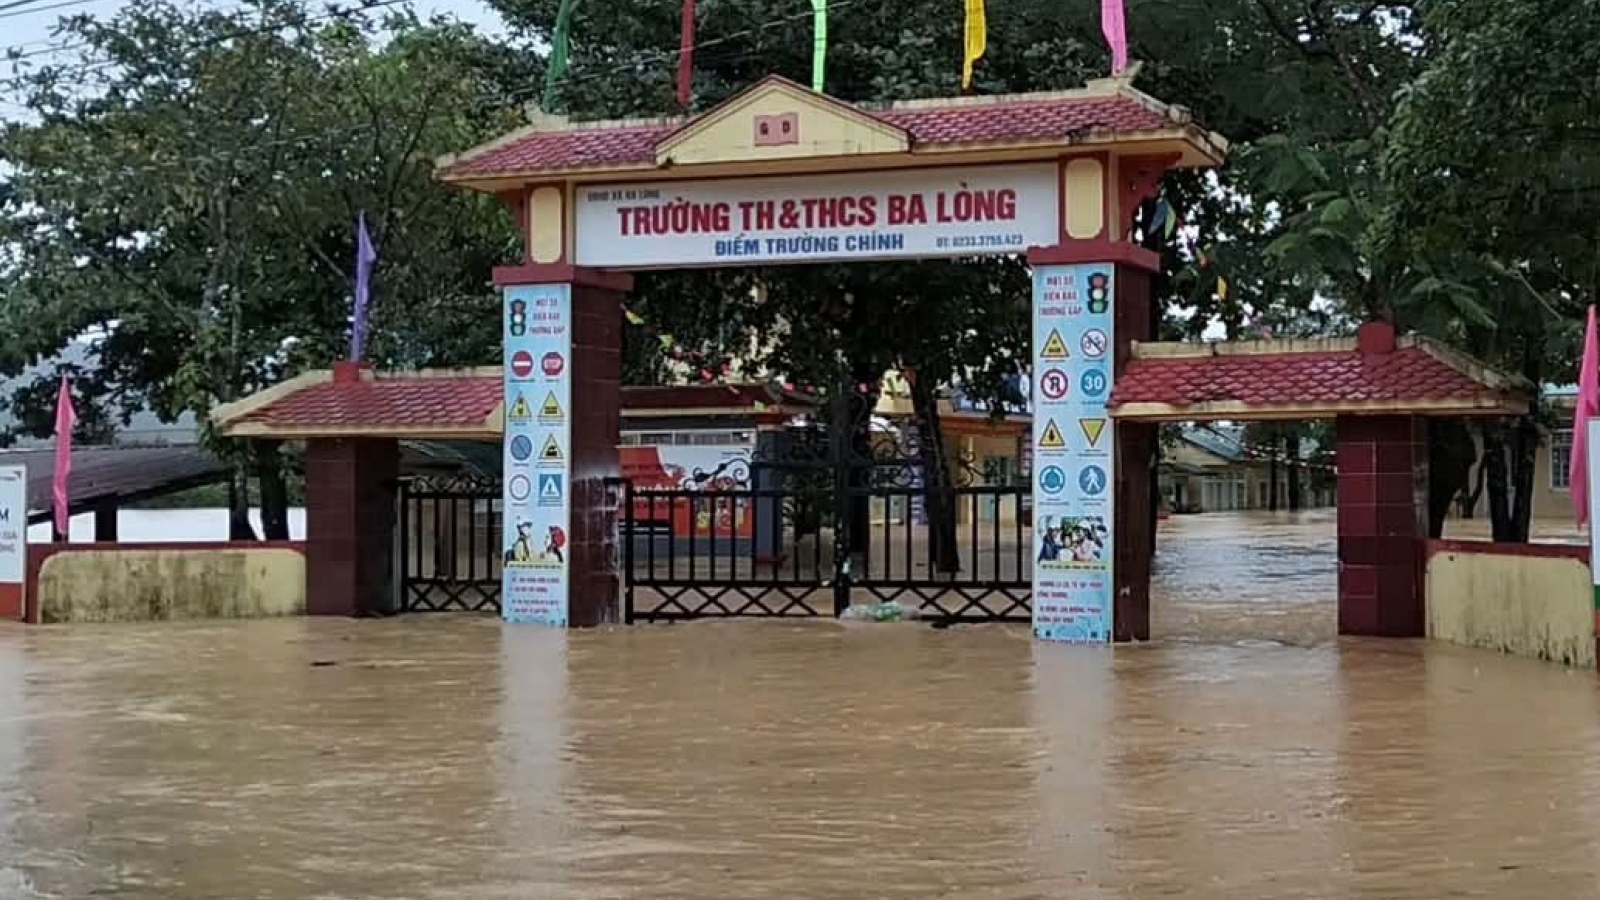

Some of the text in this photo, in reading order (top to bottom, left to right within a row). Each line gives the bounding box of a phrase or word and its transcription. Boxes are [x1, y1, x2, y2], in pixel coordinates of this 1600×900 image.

[617, 197, 731, 236] TRƯỜNG
[887, 193, 928, 226] BA
[936, 181, 1017, 223] LÒNG
[715, 229, 905, 257] ĐIỂM TRƯỜNG CHÍNH
[1083, 376, 1104, 391] 30
